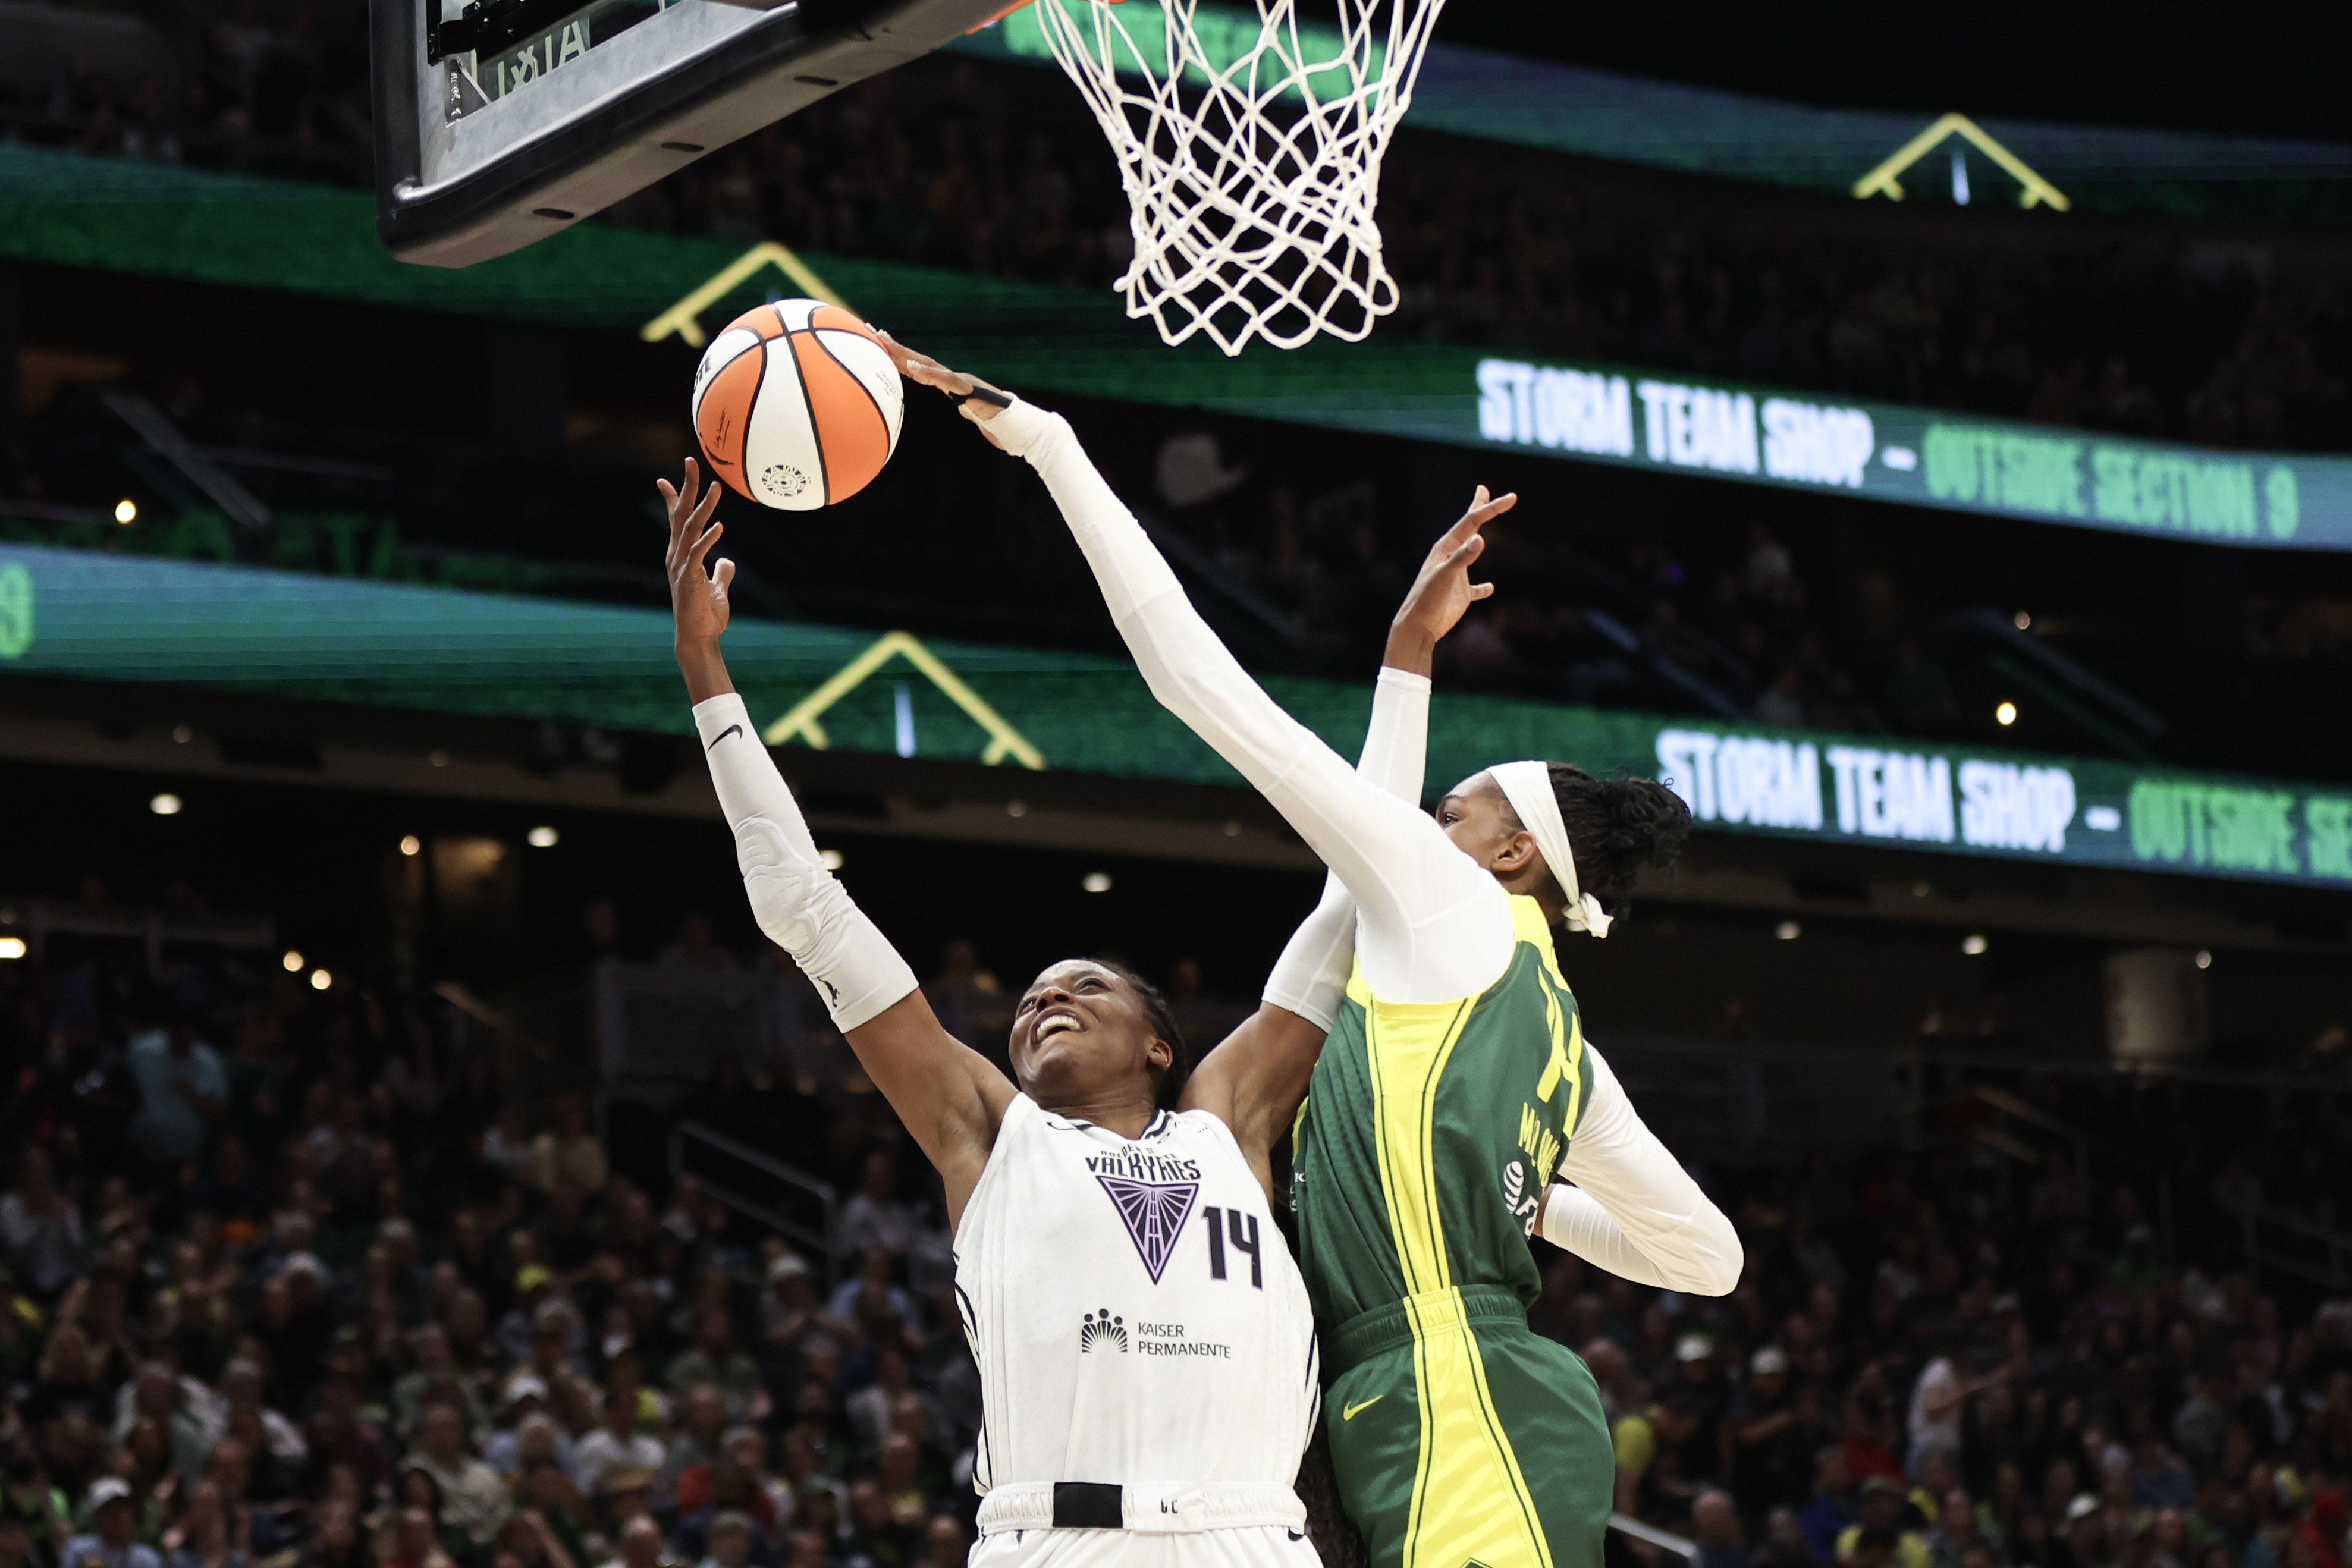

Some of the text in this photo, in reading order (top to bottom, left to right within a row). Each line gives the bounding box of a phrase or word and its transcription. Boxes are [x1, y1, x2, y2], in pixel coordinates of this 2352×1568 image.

[1477, 358, 1633, 457] STORM
[1636, 379, 1758, 475] TEAM
[1761, 397, 1874, 488] SHOP
[1924, 425, 2089, 517] OUTSIDE
[2092, 446, 2258, 539] SECTION
[1656, 728, 1823, 831] STORM
[1825, 744, 1955, 844] TEAM
[1958, 759, 2077, 853] SHOP
[2127, 780, 2301, 875] OUTSIDE
[1085, 1152, 1201, 1181] VALKYRIES
[1200, 1205, 1263, 1292] 14
[1138, 1322, 1185, 1337] KAISER
[1138, 1340, 1231, 1359] PERMANENTE
